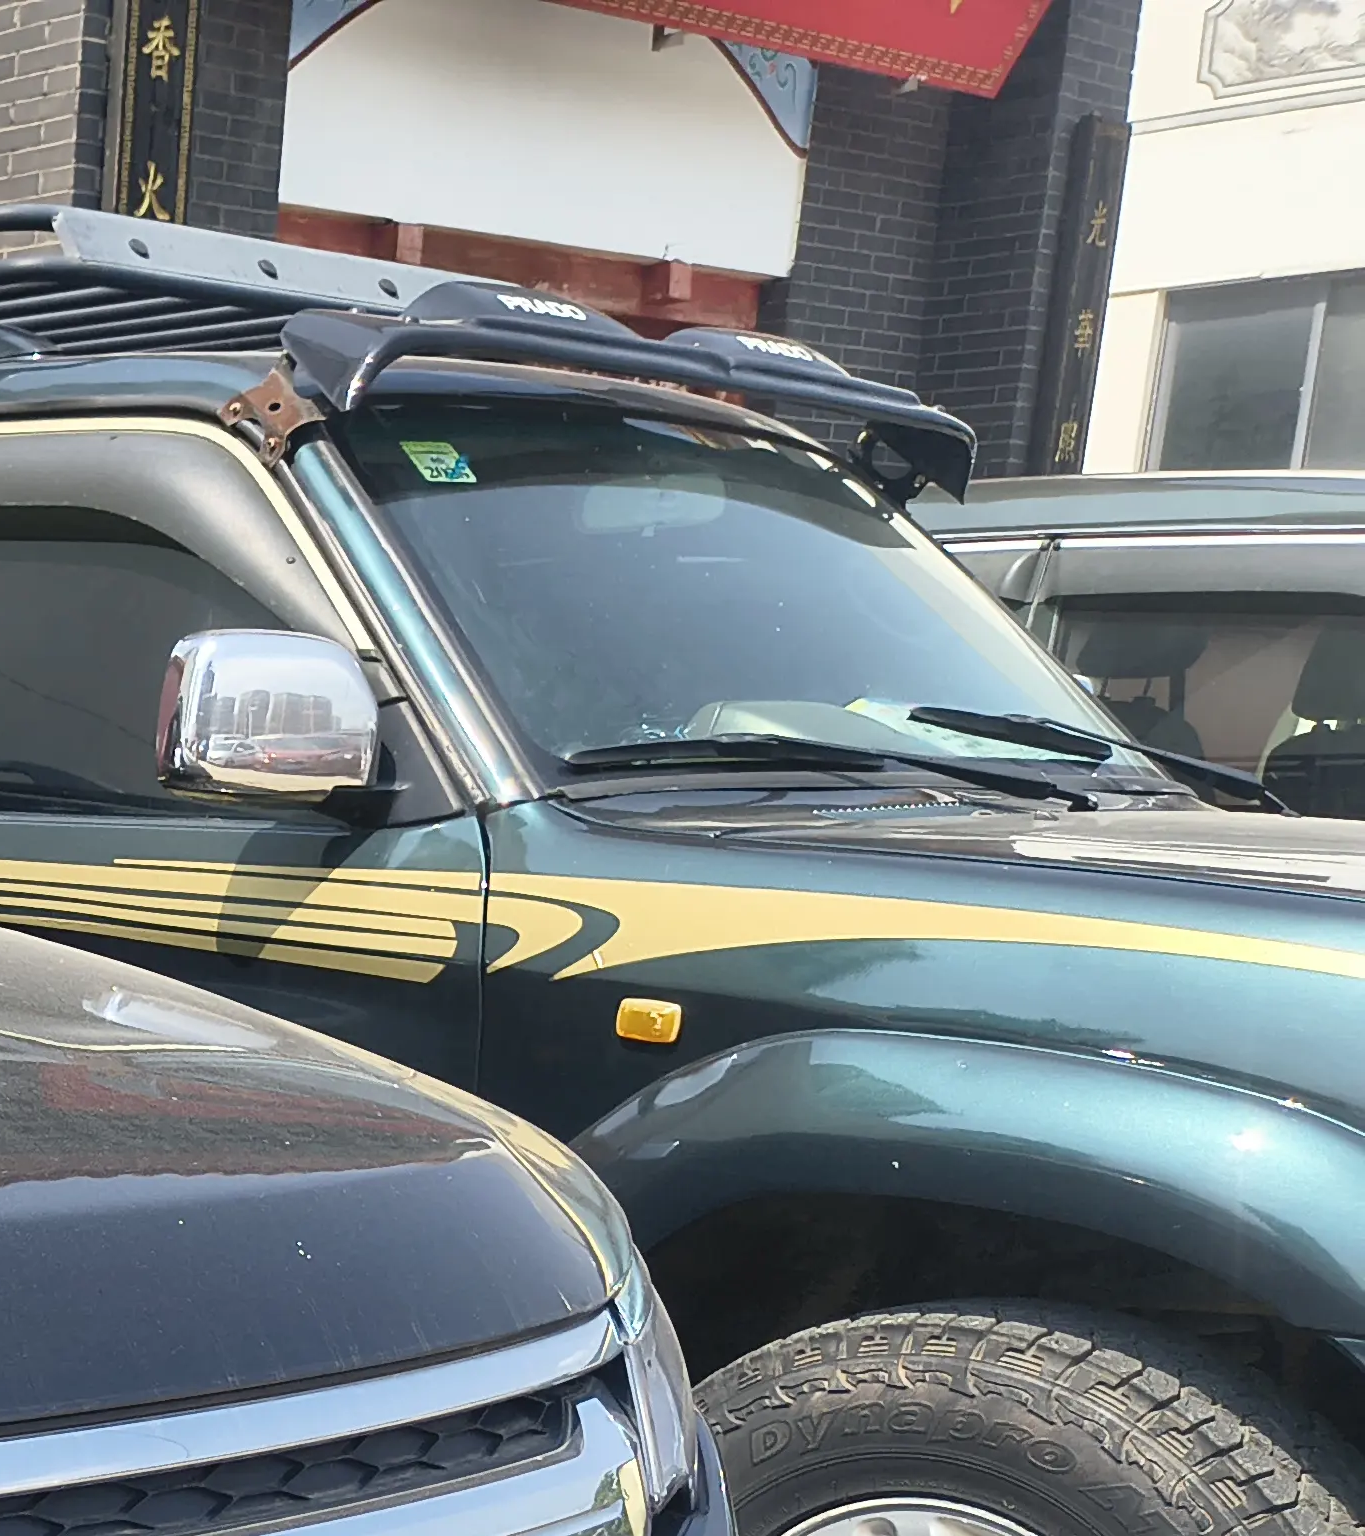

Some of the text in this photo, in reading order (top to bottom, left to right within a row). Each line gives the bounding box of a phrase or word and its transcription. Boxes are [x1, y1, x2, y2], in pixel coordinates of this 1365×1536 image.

[133, 15, 181, 221] 香火
[496, 293, 588, 321] PRADO
[734, 334, 815, 362] PRADO
[748, 1399, 1077, 1474] Dynapro
